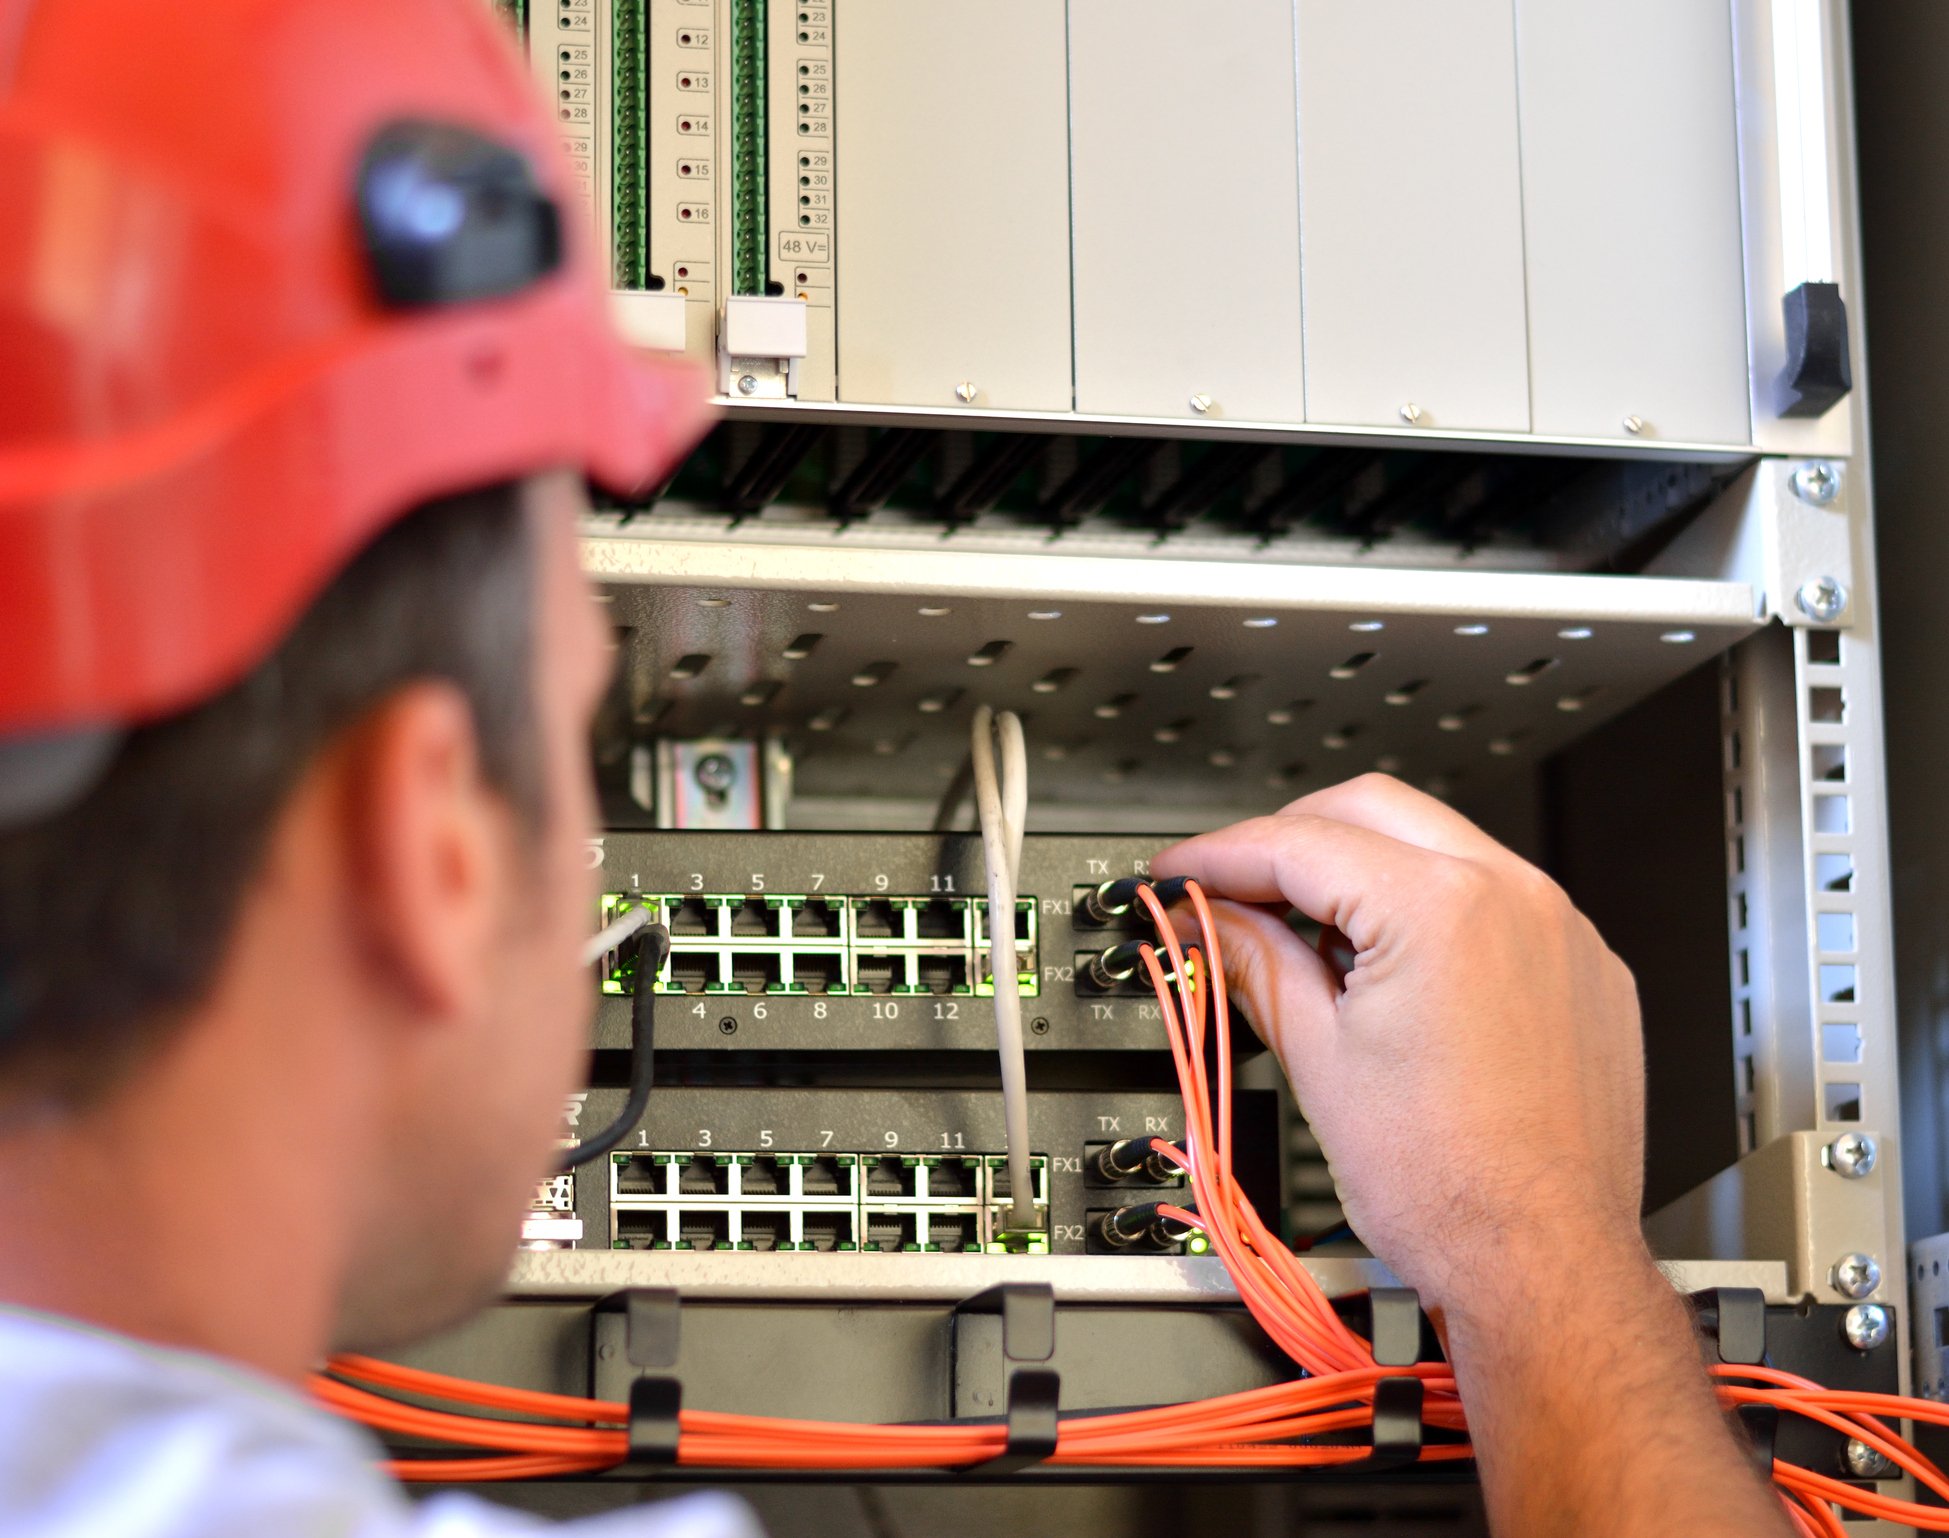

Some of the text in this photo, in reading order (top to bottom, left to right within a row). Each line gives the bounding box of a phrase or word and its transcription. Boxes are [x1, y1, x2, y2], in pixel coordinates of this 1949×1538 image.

[574, 16, 588, 26] 24
[812, 12, 826, 22] 23
[695, 34, 709, 46] 12
[812, 31, 826, 41] 24
[574, 50, 588, 60] 25
[574, 69, 588, 79] 26
[813, 65, 827, 75] 25
[695, 77, 709, 88] 13
[574, 88, 587, 99] 27
[813, 84, 827, 94] 26
[574, 107, 588, 118] 28
[813, 103, 827, 113] 27
[695, 121, 709, 132] 14
[813, 122, 827, 132] 28
[573, 142, 588, 153] 29
[574, 161, 588, 172] 30
[814, 156, 827, 166] 29
[695, 164, 709, 175] 15
[814, 175, 828, 185] 30
[814, 194, 827, 205] 31
[695, 208, 709, 219] 16
[814, 214, 828, 224] 32
[783, 240, 801, 253] 48
[1086, 860, 1109, 874] TX
[631, 873, 955, 892] 1 3 5 7 9 11
[1042, 900, 1072, 915] FX1
[1044, 967, 1074, 982] FX2
[692, 1003, 959, 1019] 4 6 8 10 12
[1091, 1005, 1160, 1019] TX RX
[1097, 1117, 1168, 1132] TX RX
[638, 1130, 965, 1149] 1 3 5 7 9 11
[1052, 1157, 1082, 1172] FX1
[1054, 1225, 1084, 1240] FX2
